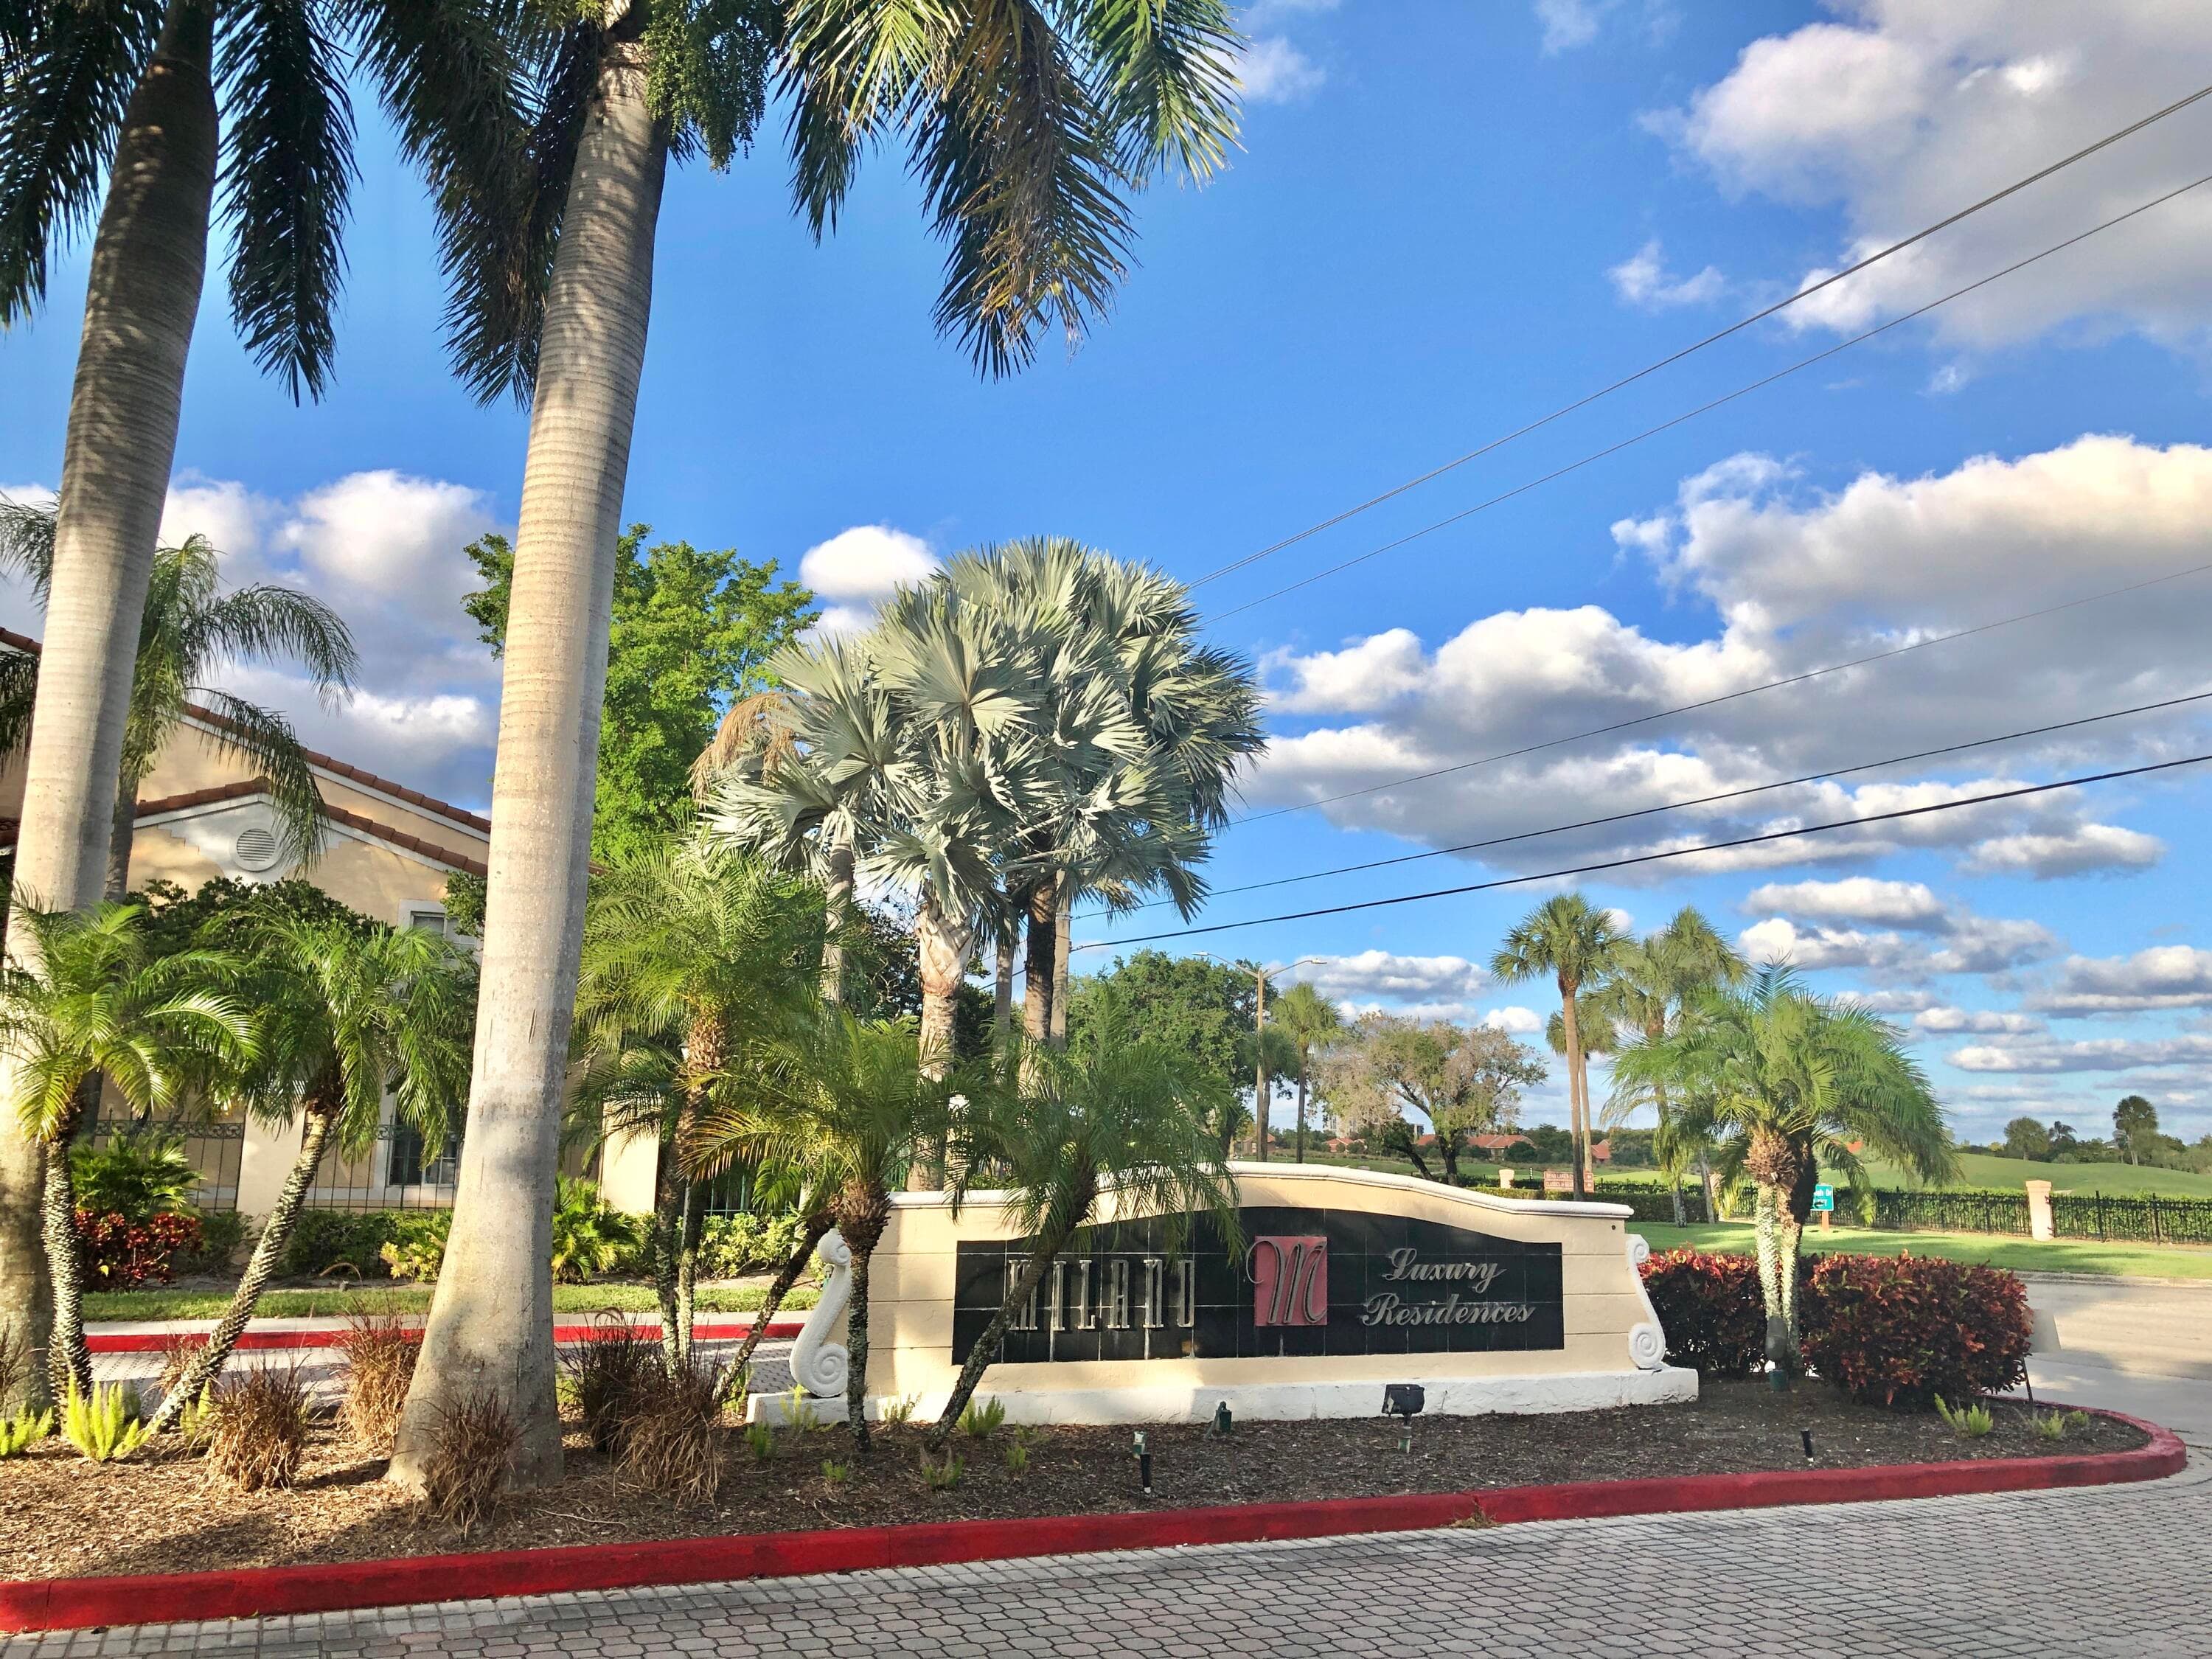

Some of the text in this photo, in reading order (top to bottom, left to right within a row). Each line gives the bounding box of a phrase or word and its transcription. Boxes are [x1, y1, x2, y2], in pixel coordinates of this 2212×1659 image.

[1381, 1248, 1507, 1293] Luxury
[1008, 1259, 1194, 1331] MILANO
[1360, 1293, 1536, 1326] Residences
